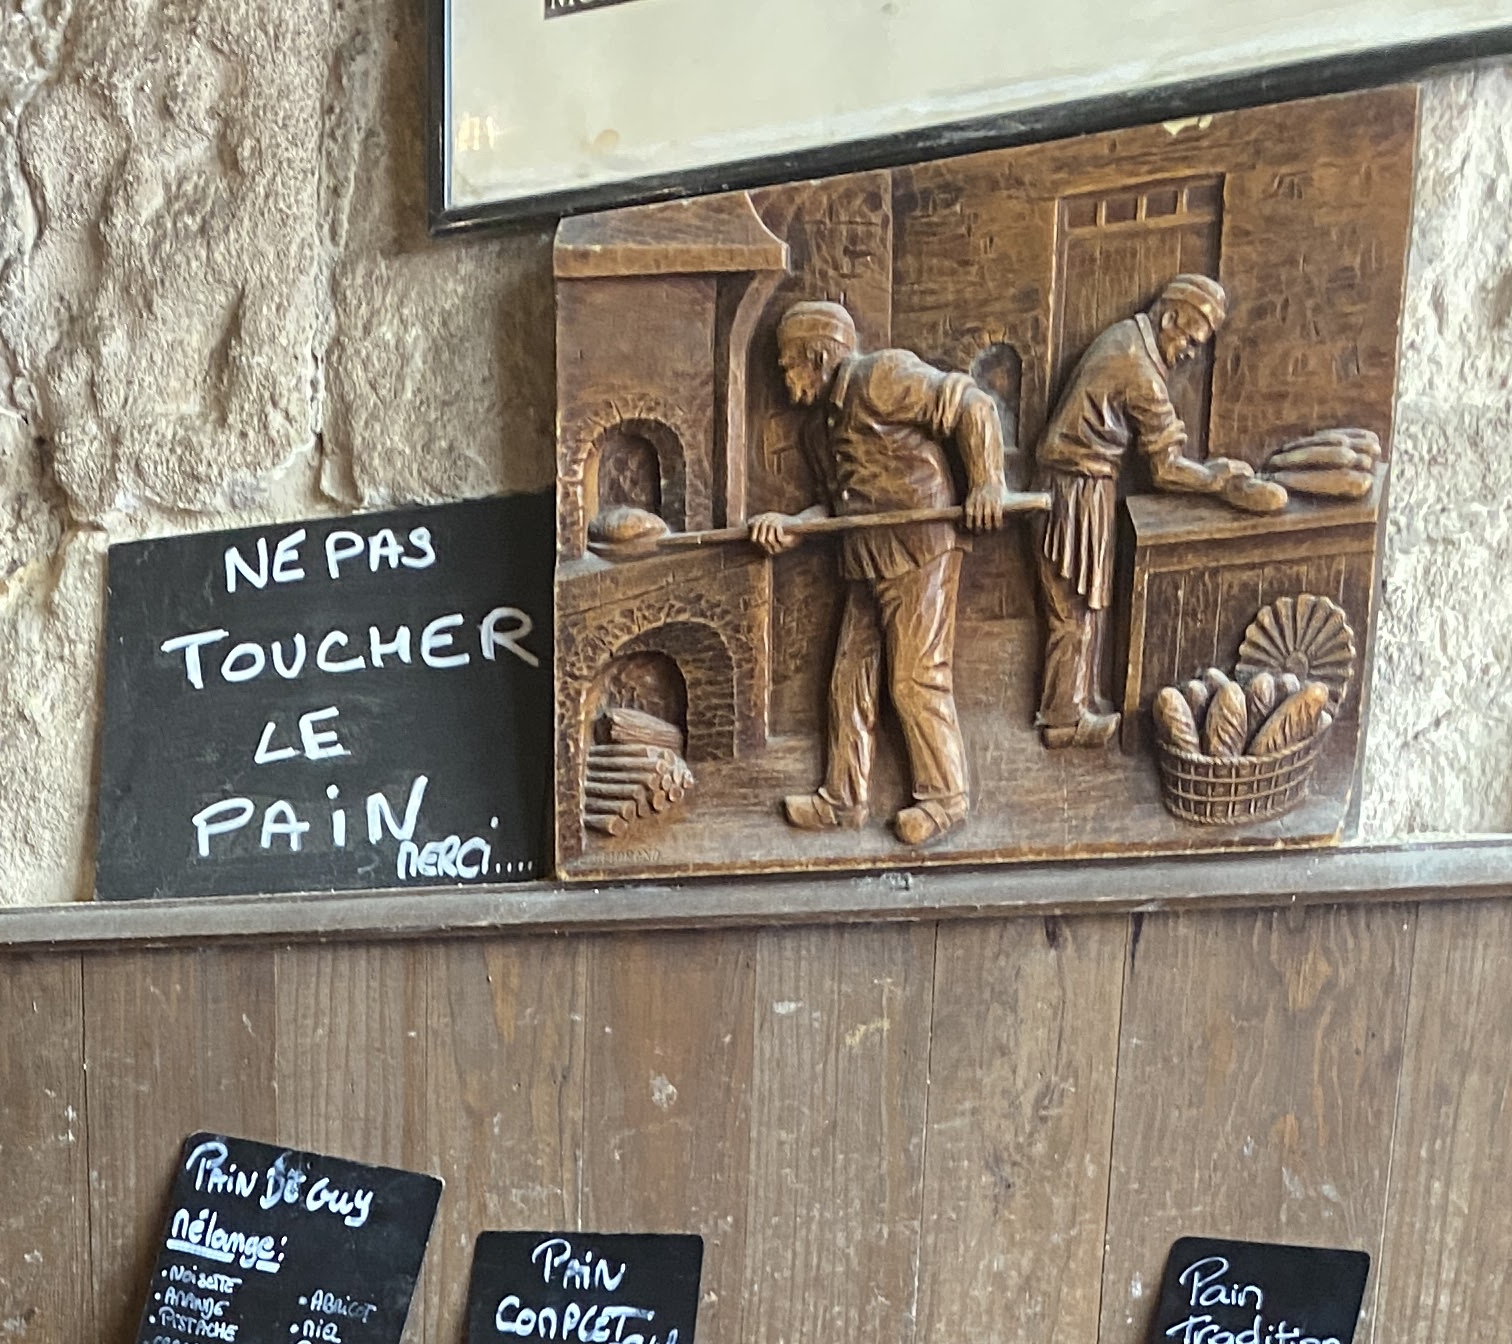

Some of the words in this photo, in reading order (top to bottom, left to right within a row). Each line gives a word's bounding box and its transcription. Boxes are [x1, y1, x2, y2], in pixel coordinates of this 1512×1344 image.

[223, 529, 307, 593] NE
[324, 526, 437, 579] PAS
[161, 606, 539, 690] TOUCHER
[253, 706, 352, 764] LE
[1178, 1256, 1263, 1310] Pain
[495, 1295, 655, 1342] COMPLET
